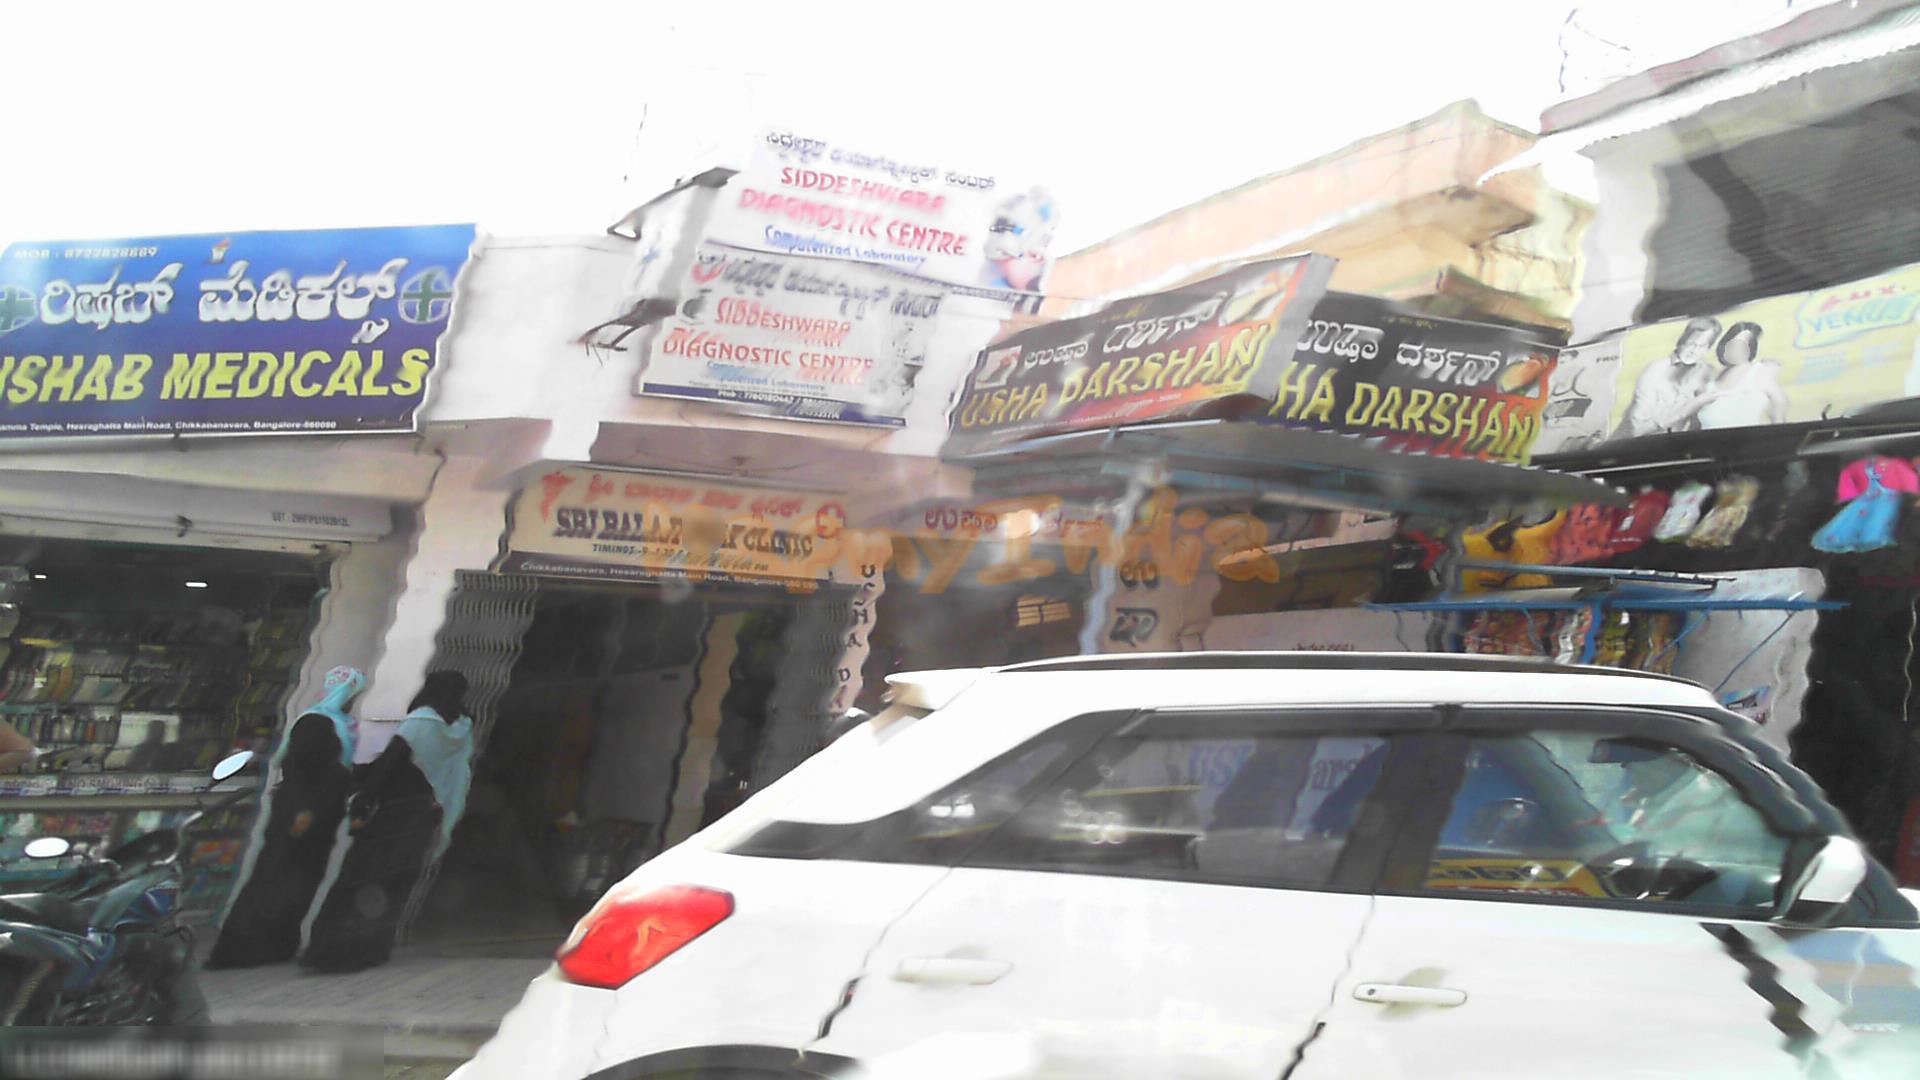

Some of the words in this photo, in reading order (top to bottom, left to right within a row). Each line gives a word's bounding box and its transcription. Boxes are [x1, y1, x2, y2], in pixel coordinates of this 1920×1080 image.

[781, 166, 946, 213] SIDDESHWARA
[738, 188, 879, 238] DIAGNOSTIC
[886, 219, 969, 256] CENTRE
[855, 245, 927, 269] Laboratory
[662, 327, 792, 368] DIAGNOSTIC
[160, 348, 432, 401] MEDICALS
[961, 382, 1048, 430] USHA
[1057, 322, 1278, 405] DARSHAN
[1345, 382, 1542, 466] DARSHAN
